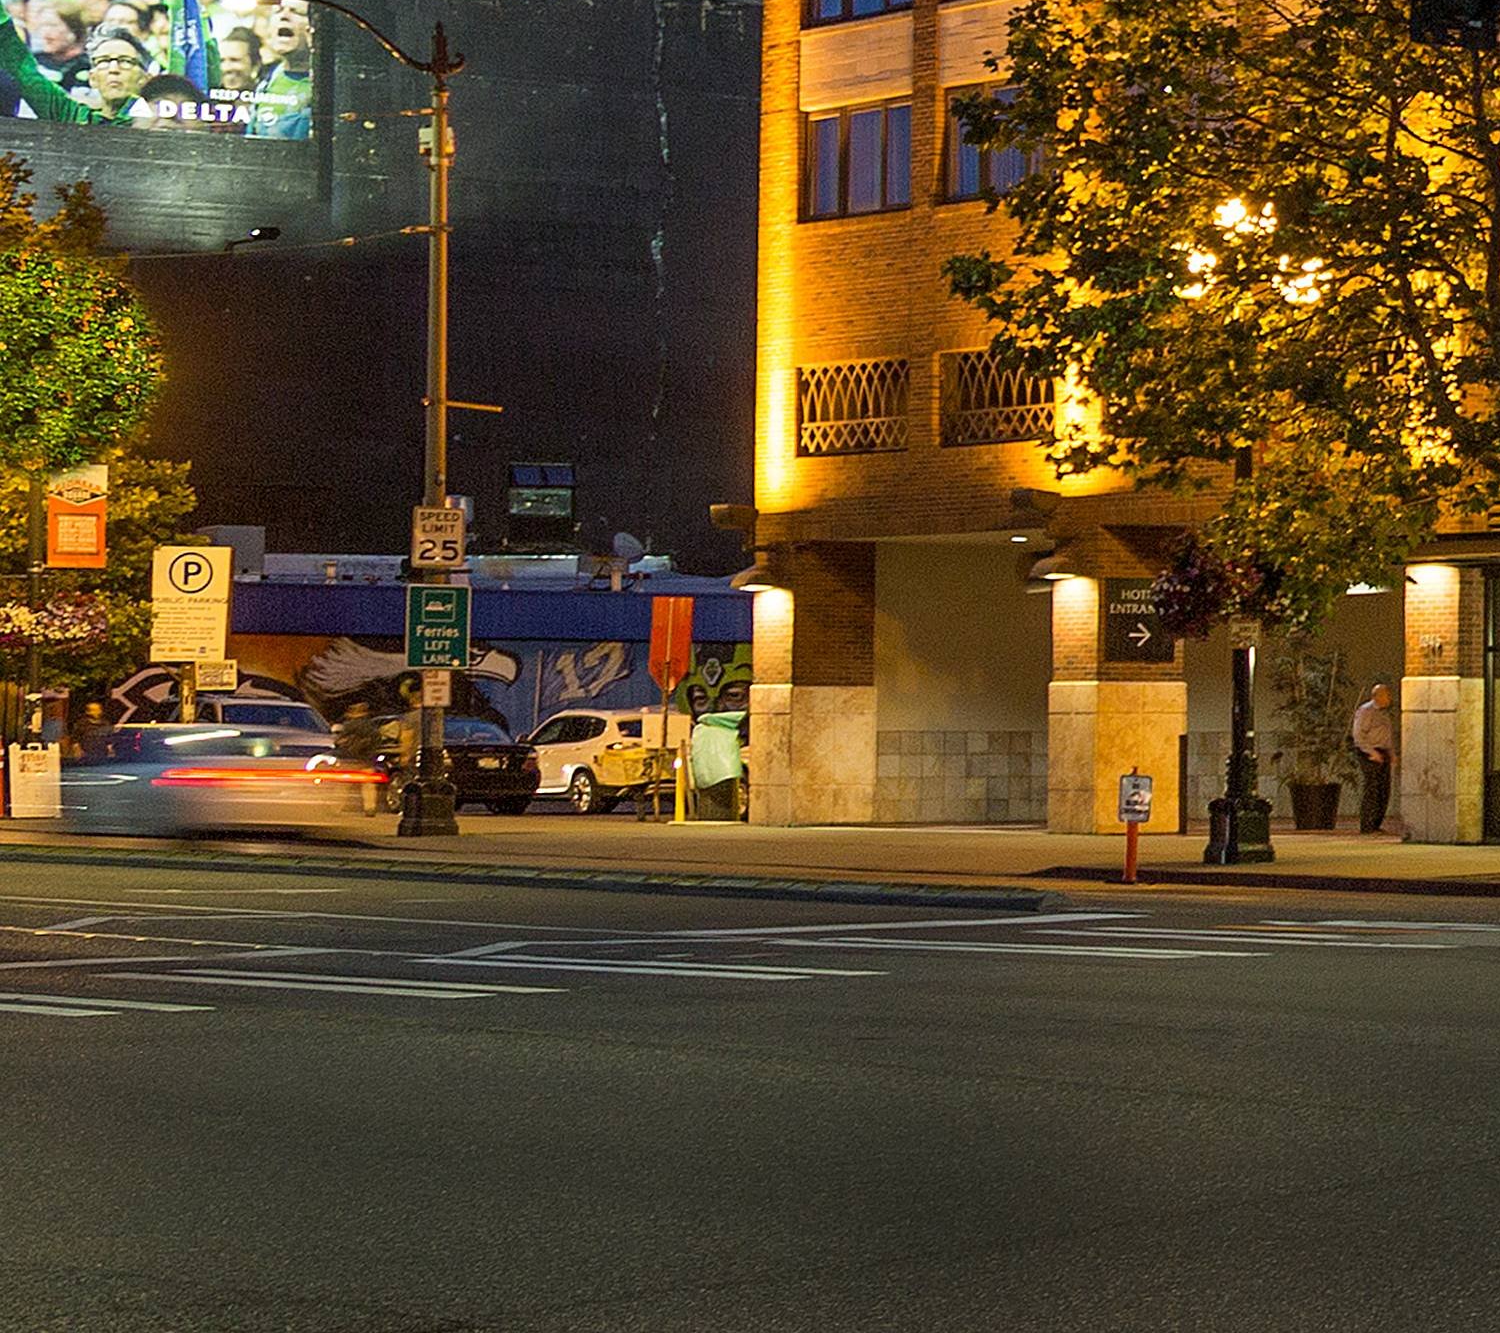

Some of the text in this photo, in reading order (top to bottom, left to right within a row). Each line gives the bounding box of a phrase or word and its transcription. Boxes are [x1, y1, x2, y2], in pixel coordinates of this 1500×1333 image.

[158, 99, 251, 124] DELTA
[419, 511, 460, 522] SPEED
[422, 523, 456, 533] LIMIT
[418, 539, 459, 561] 25
[416, 625, 460, 638] Ferries
[424, 640, 450, 651] LEFT
[422, 654, 452, 665] LANE
[555, 641, 629, 702] 12
